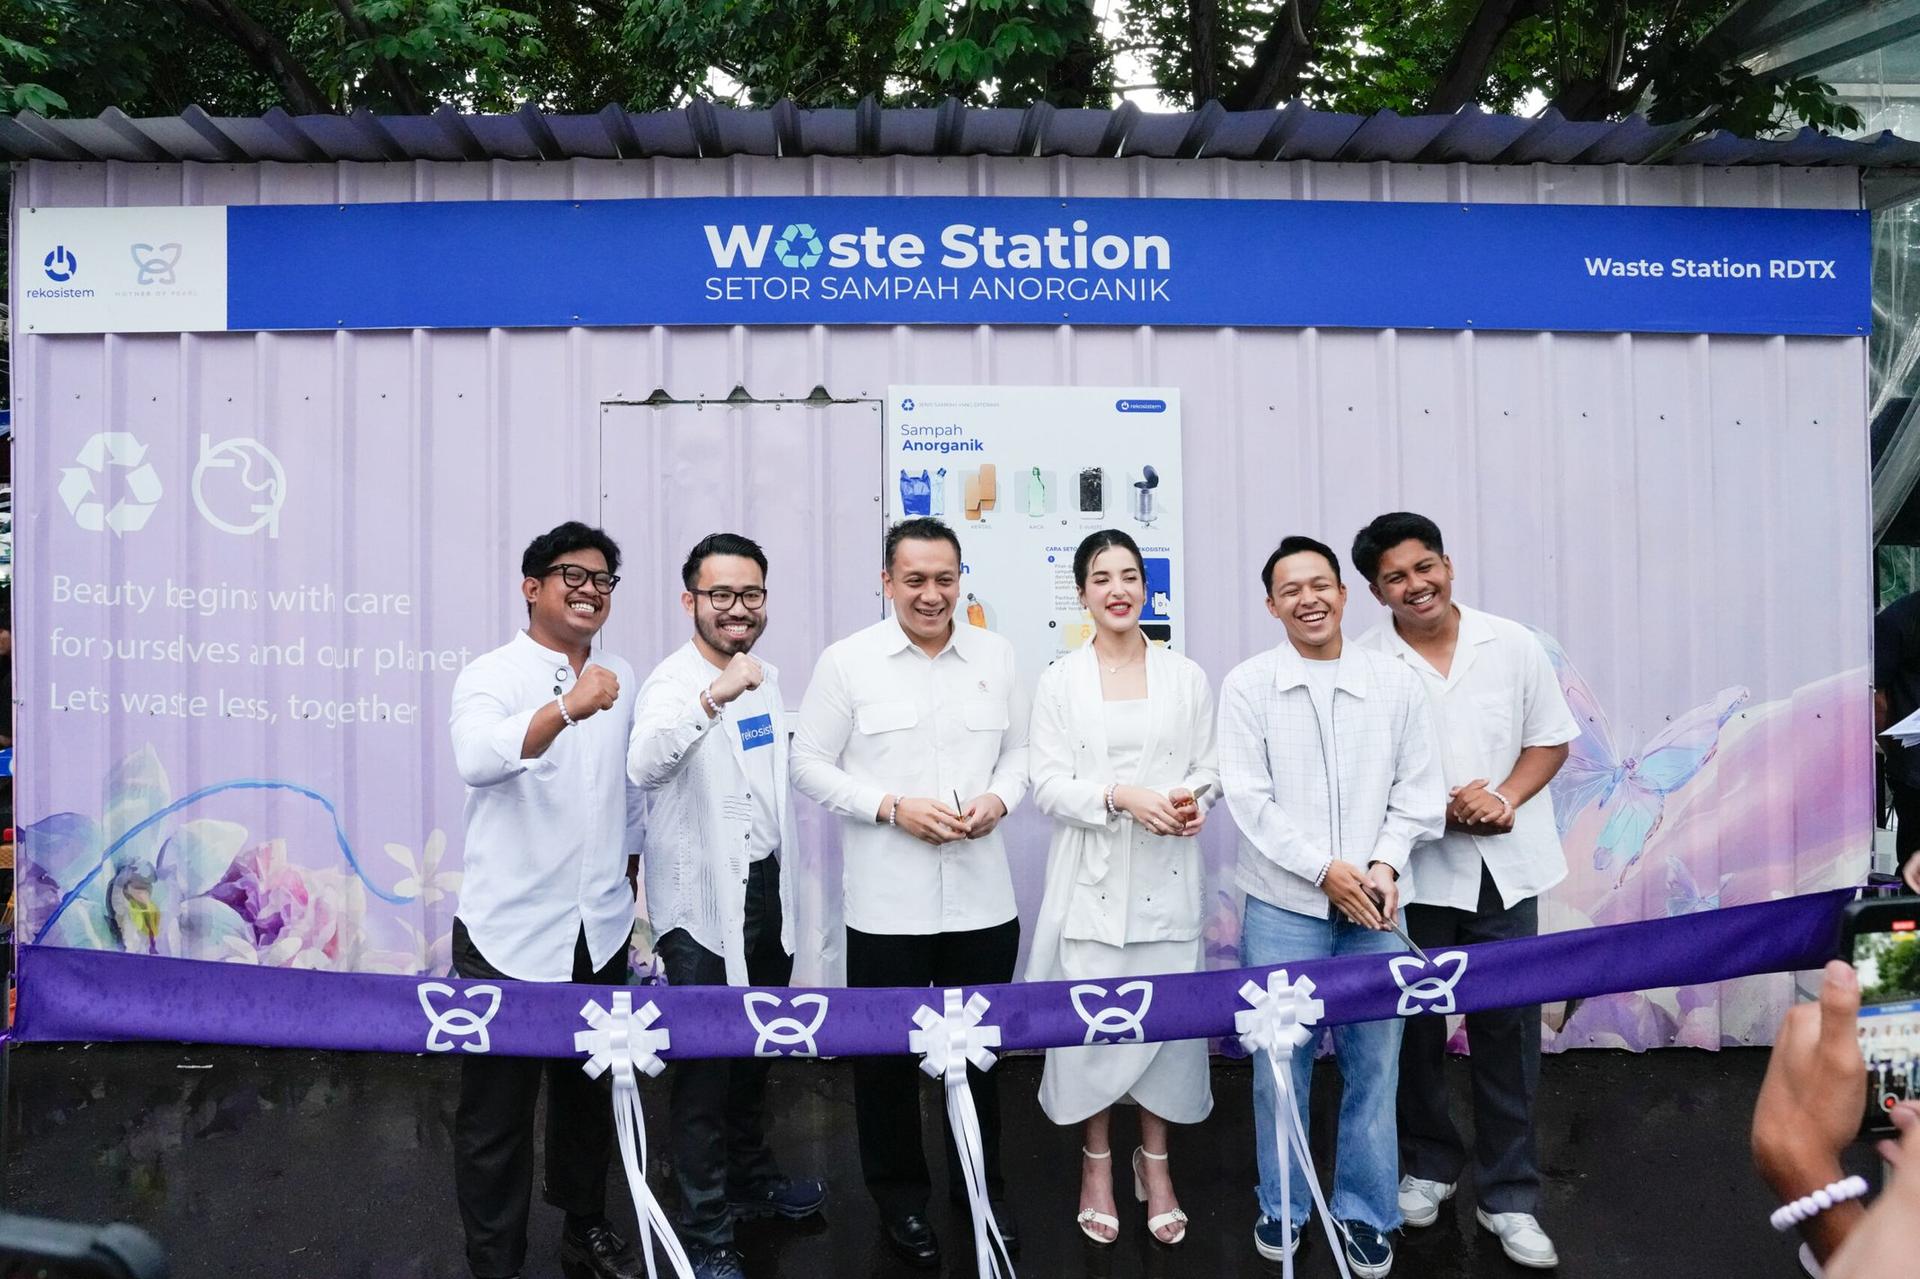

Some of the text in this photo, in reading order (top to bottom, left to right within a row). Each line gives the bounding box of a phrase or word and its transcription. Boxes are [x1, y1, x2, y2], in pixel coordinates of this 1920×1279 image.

[703, 219, 1171, 271] Wste Station
[1584, 257, 1836, 279] Waste Station RDTX
[26, 287, 95, 298] rekosistem
[705, 277, 1171, 301] SETOR SAMPAH ANORGANIK
[901, 424, 963, 438] Sampah
[902, 439, 984, 454] Anorganik
[52, 575, 411, 616] Beauty begins with care
[50, 627, 471, 675] for ourselves and our planet
[50, 683, 417, 729] Lets waste less, together
